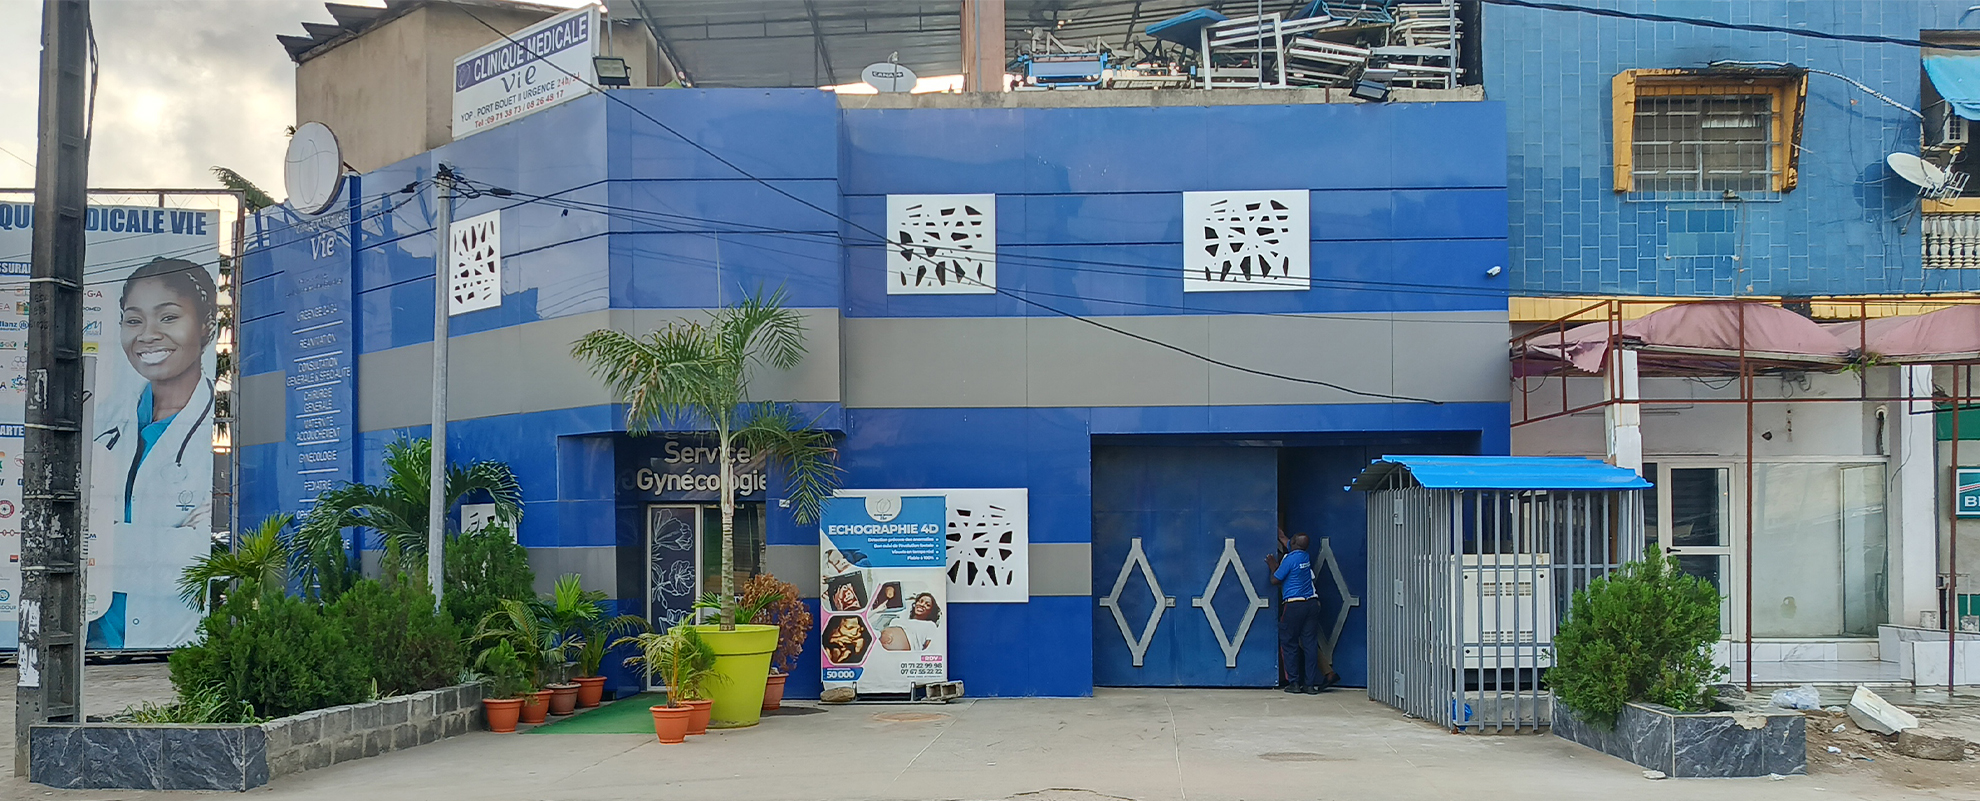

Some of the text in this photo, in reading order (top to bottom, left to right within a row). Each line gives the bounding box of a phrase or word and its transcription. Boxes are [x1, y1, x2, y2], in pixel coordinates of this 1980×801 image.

[474, 15, 587, 81] CLINIQUE MEDICALE
[477, 102, 493, 117] PORT
[494, 95, 516, 110] BOUET
[523, 80, 555, 100] URGENCE
[556, 89, 564, 99] 17
[0, 204, 206, 235] QU DICALE VIE
[664, 441, 750, 464] Servce
[828, 524, 939, 535] ECHOGRAPHIE 4D
